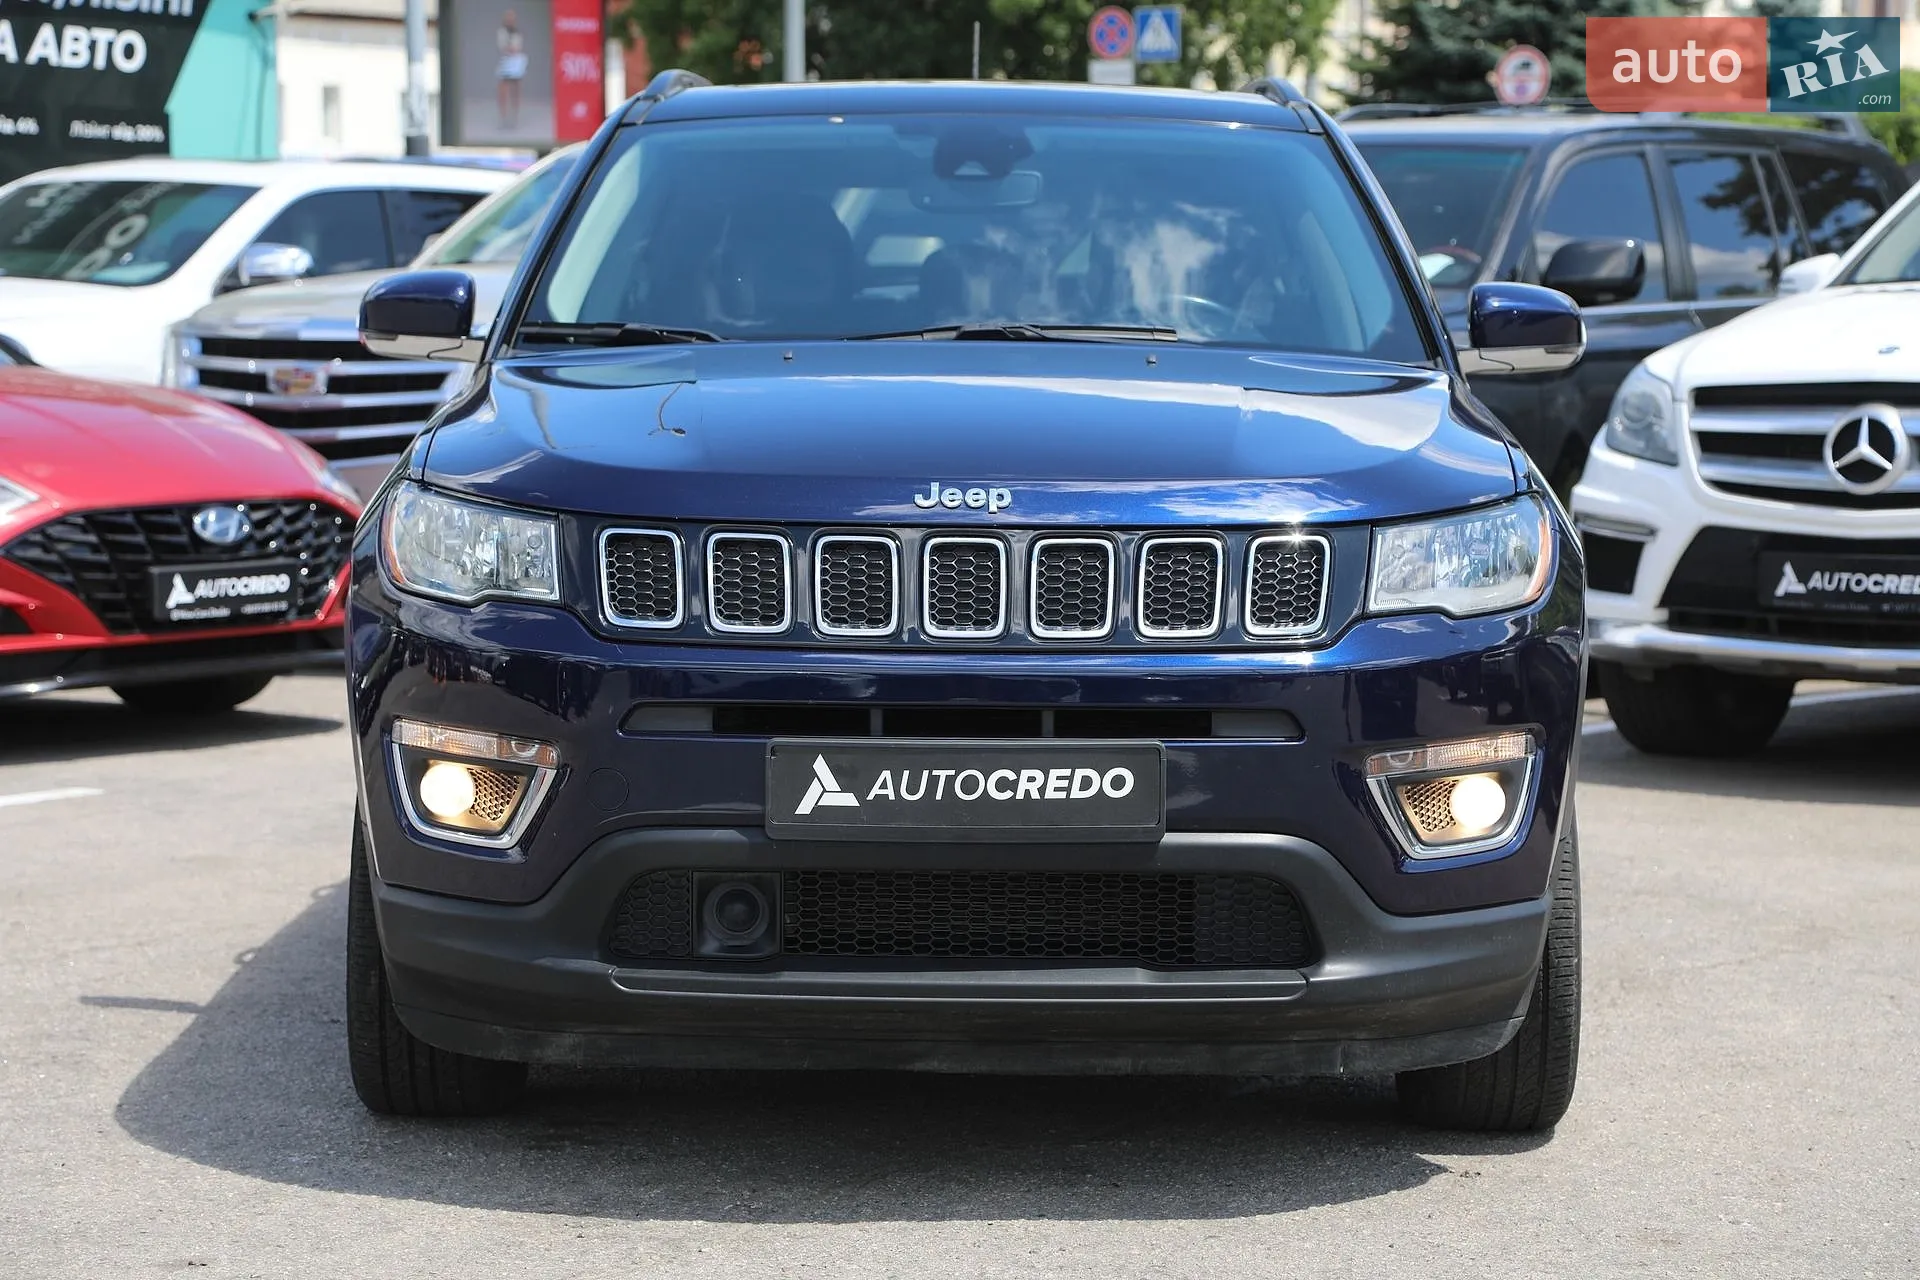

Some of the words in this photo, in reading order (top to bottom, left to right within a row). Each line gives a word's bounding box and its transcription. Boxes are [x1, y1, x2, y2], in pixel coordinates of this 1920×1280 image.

[25, 22, 147, 73] АВТО
[914, 481, 1012, 514] Jeep
[866, 767, 1135, 800] AUTOCREDO
